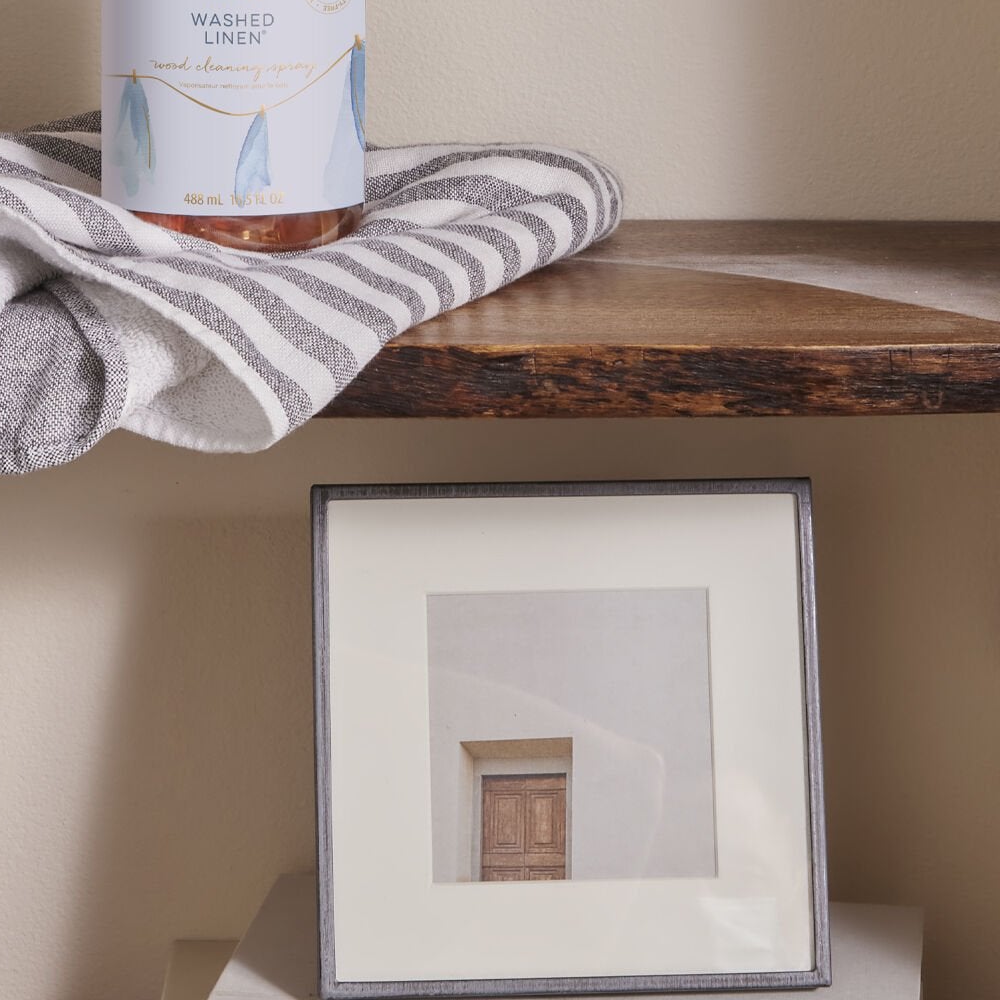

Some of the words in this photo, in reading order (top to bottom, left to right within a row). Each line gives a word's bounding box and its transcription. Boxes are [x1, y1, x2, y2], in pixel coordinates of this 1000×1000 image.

[190, 12, 275, 27] WASHED
[149, 55, 192, 71] wood
[195, 55, 264, 82] cleaning
[183, 192, 204, 205] 488
[207, 193, 224, 206] mL
[255, 193, 267, 205] FL
